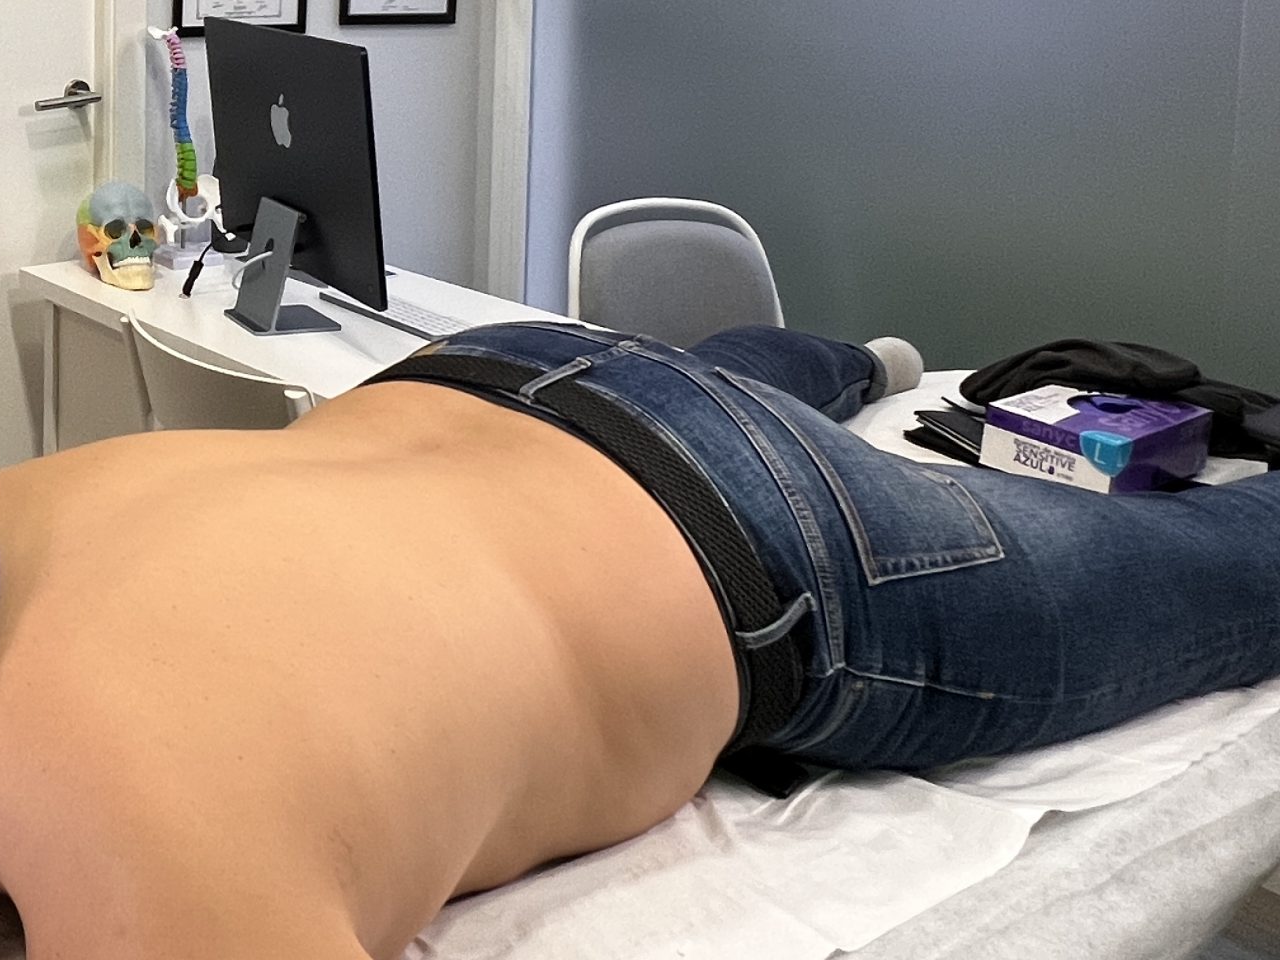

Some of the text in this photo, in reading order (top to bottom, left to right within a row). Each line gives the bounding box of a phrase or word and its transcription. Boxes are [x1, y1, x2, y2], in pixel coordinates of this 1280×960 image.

[1013, 452, 1046, 473] AZUL
[1015, 443, 1076, 472] SENSITIVE
[1094, 441, 1107, 465] L
